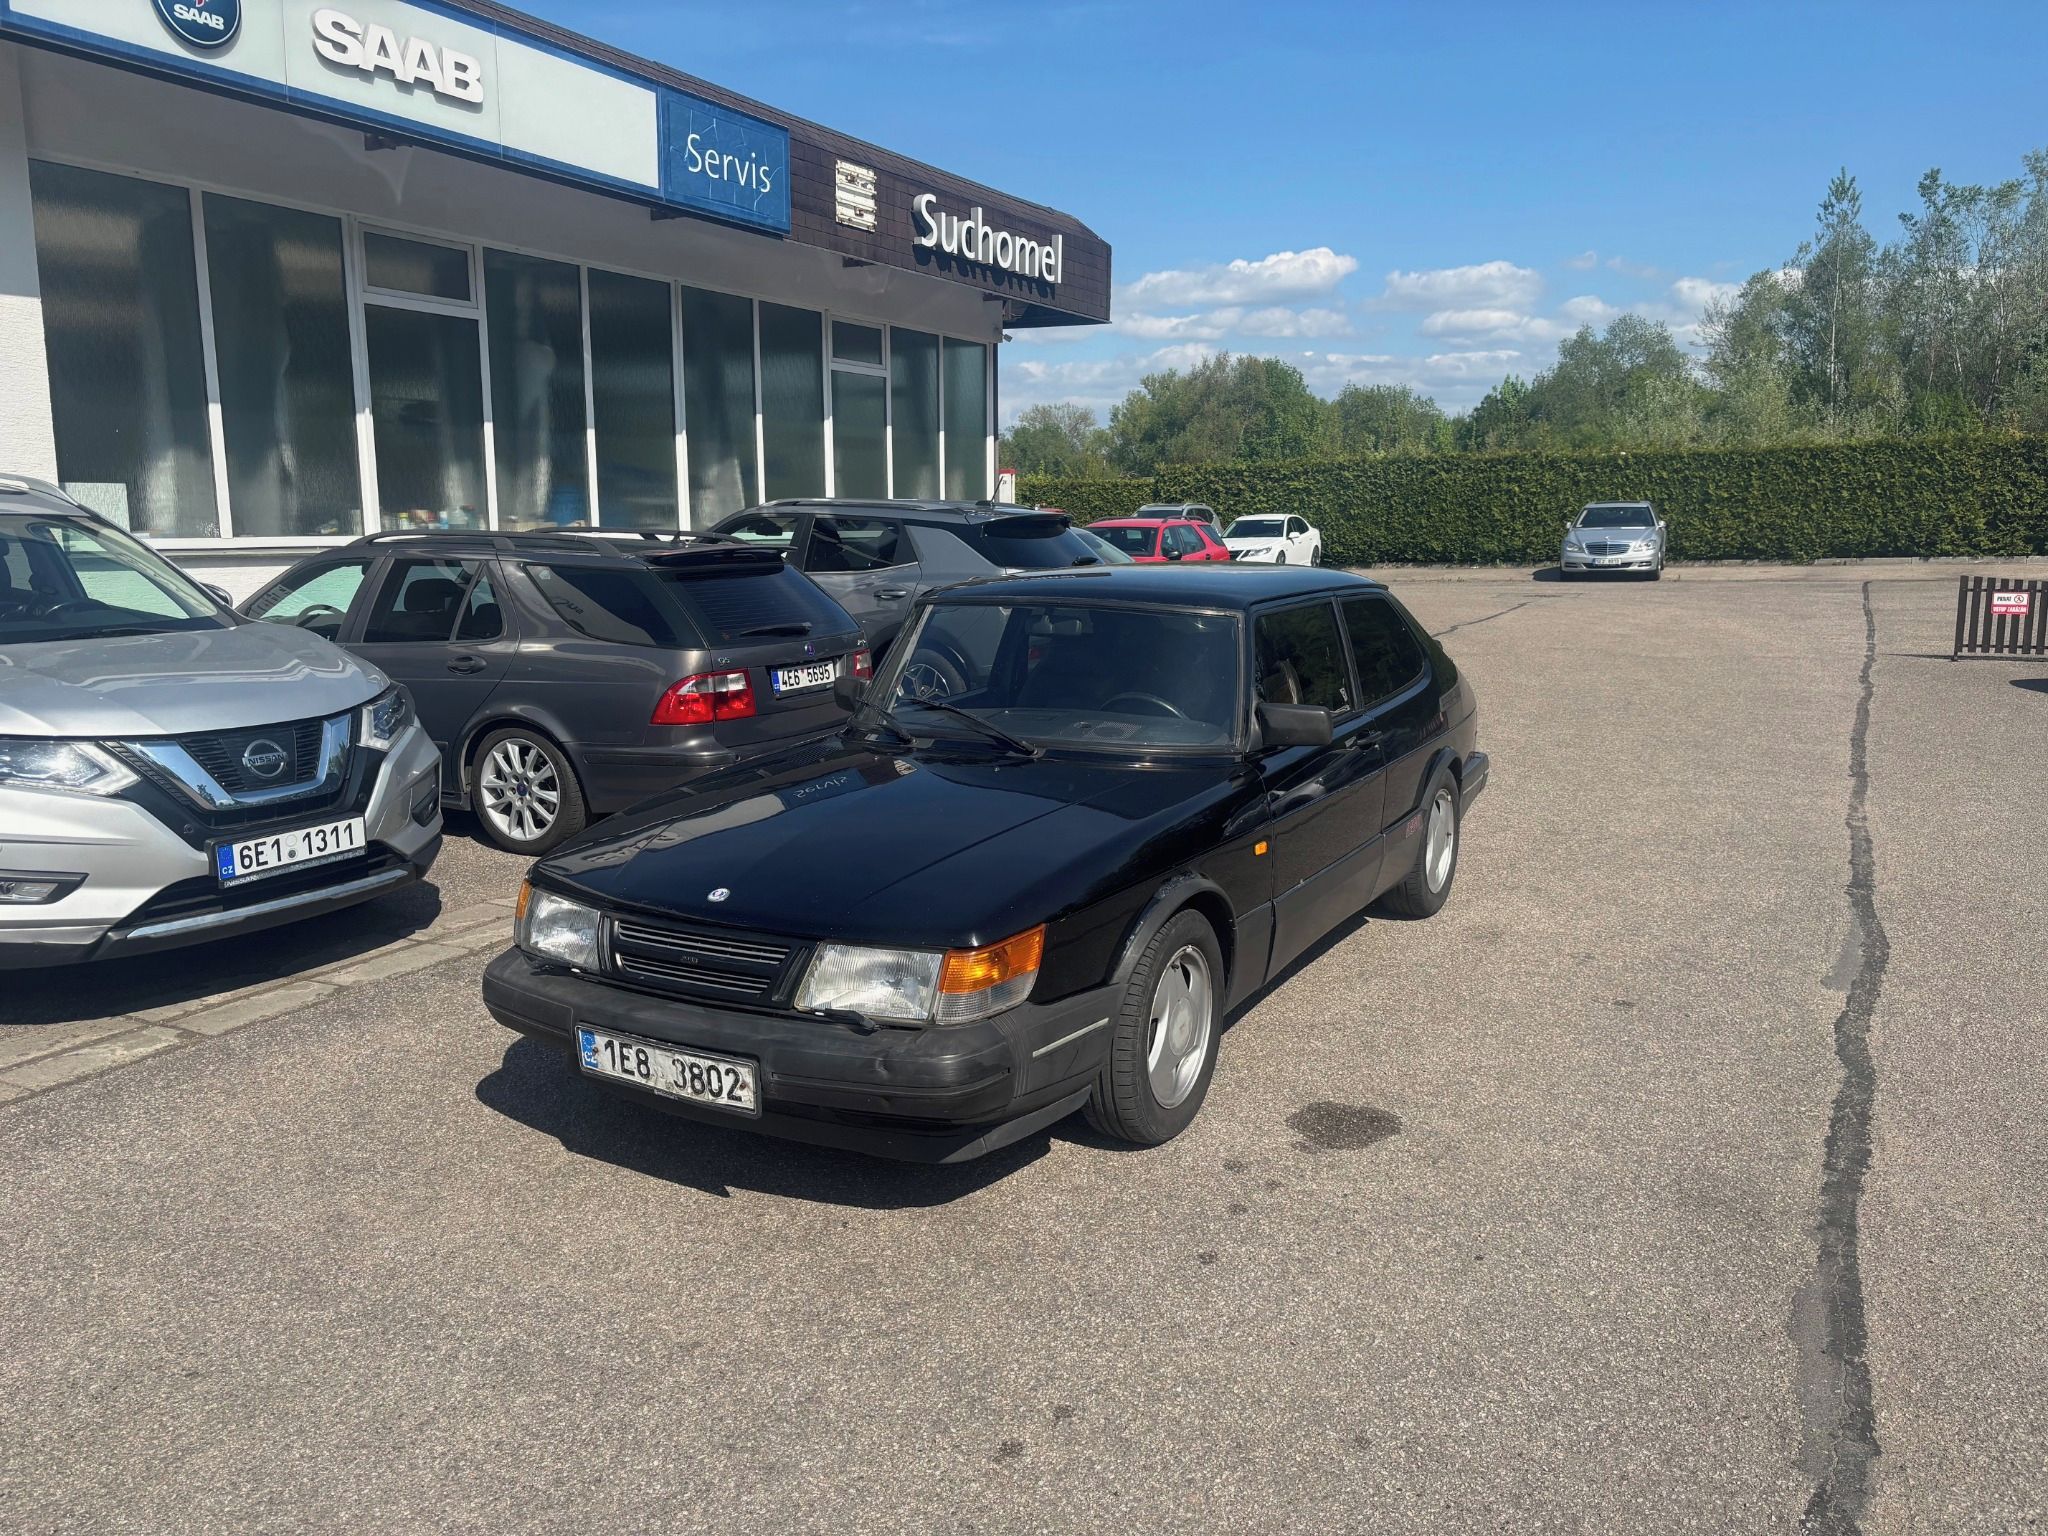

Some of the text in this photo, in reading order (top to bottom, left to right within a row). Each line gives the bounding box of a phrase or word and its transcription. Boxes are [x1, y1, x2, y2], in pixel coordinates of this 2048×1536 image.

[173, 4, 225, 31] SAAB
[312, 8, 484, 104] SAAB
[687, 133, 771, 193] Servis
[913, 193, 1063, 284] Suchomel
[782, 664, 830, 688] 4E6 5695
[247, 753, 285, 765] NISSAN
[222, 865, 234, 875] CZ
[239, 838, 282, 870] 6E1
[302, 822, 354, 855] 1311
[604, 1039, 743, 1102] 1E8 3802
